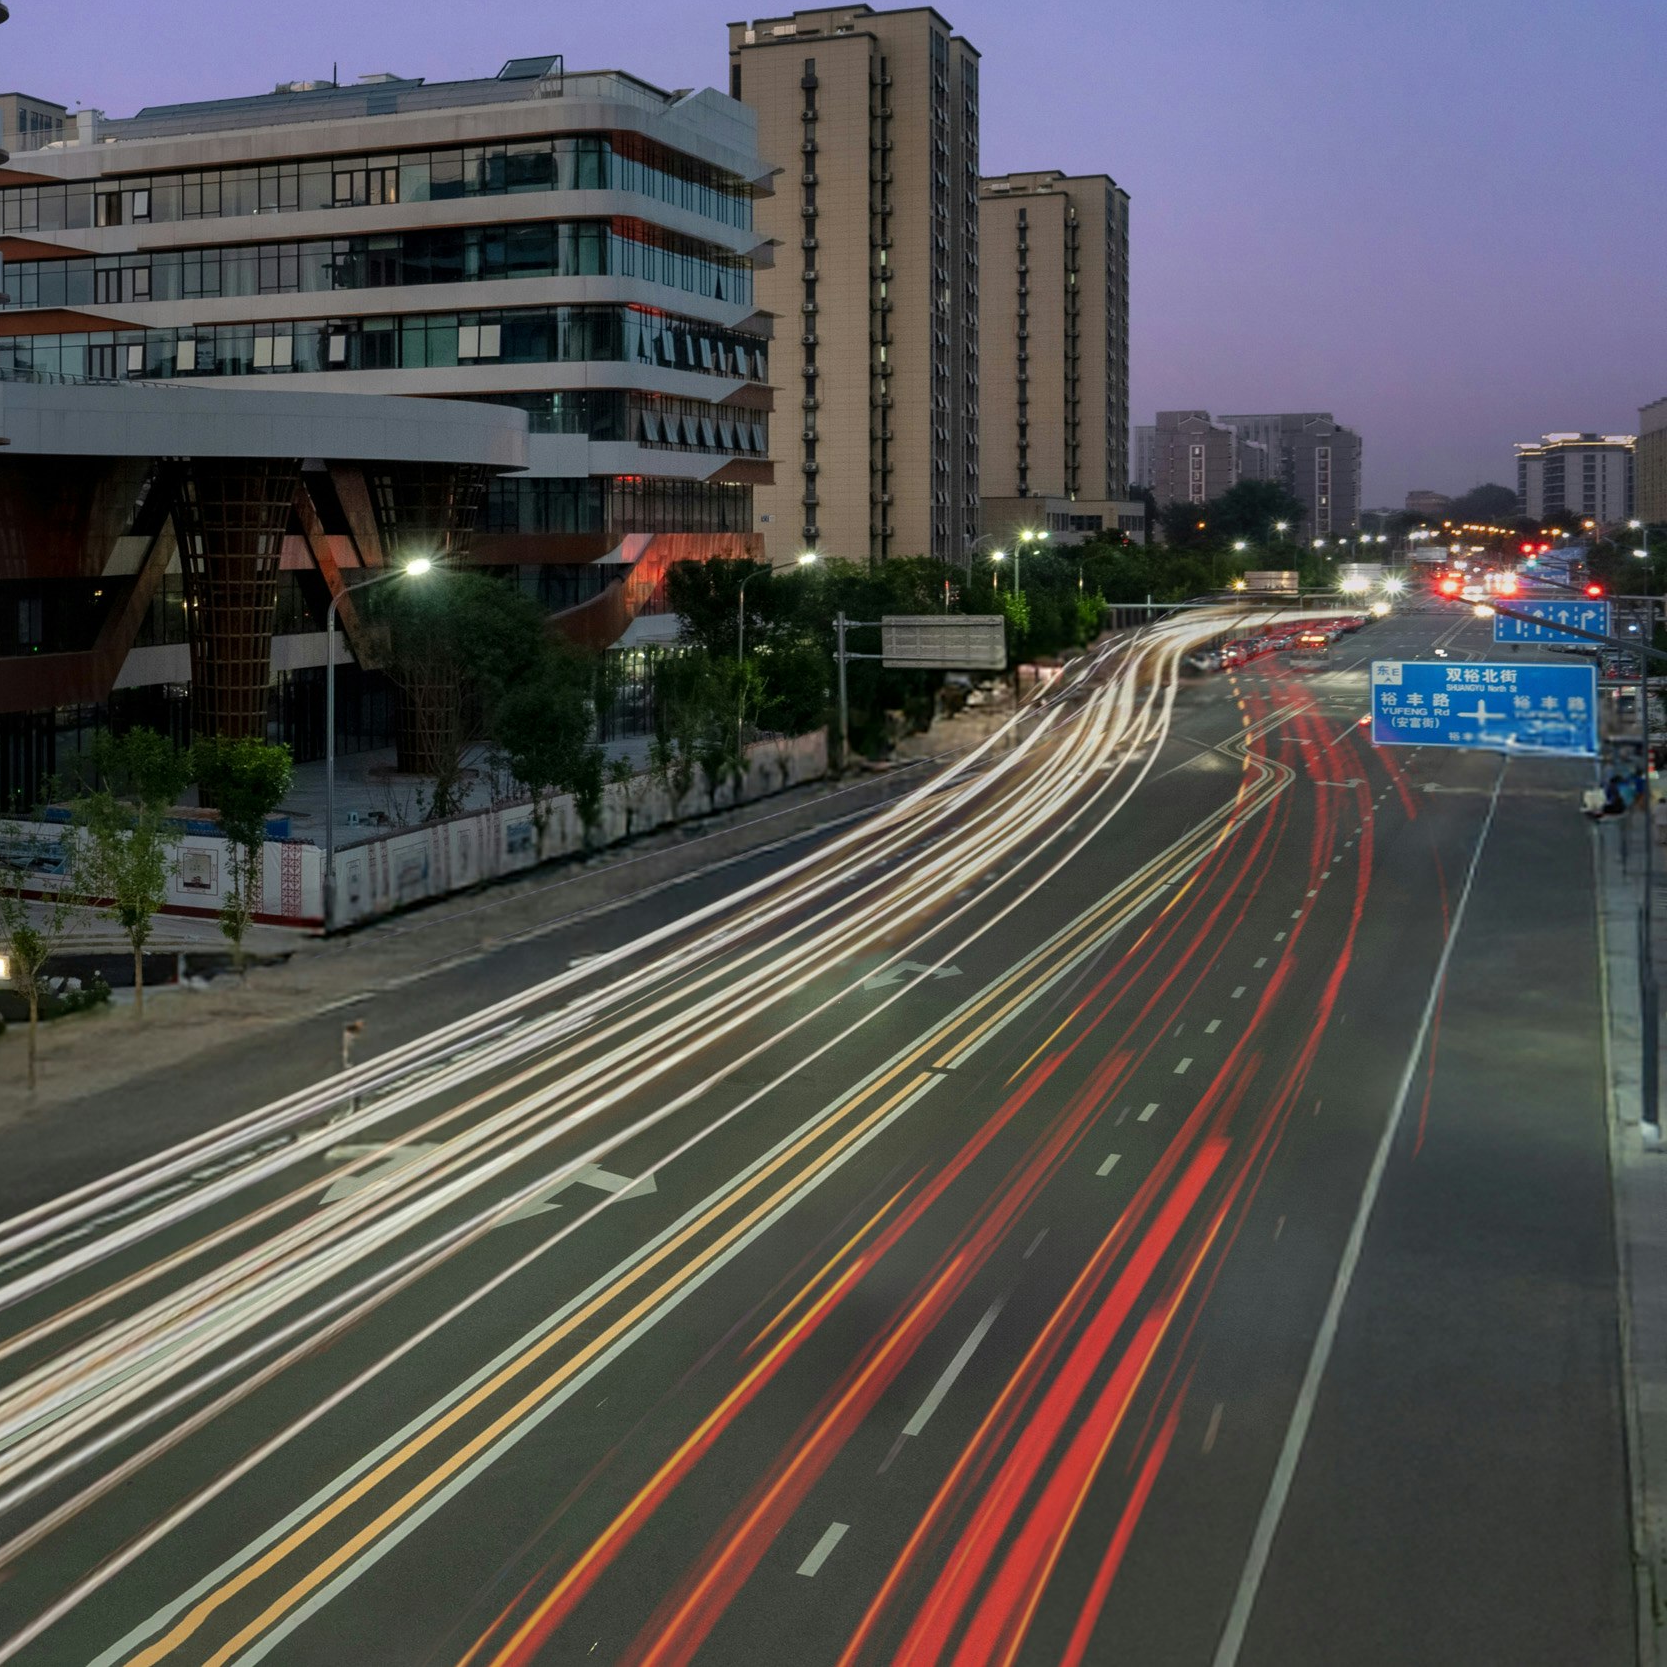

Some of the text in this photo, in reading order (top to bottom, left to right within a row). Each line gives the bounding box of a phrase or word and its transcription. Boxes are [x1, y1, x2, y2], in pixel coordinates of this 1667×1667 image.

[1377, 666, 1389, 676] 东
[1392, 668, 1400, 676] E
[1446, 667, 1517, 683] 双裕北街
[1446, 684, 1485, 692] SHUANGYU
[1380, 692, 1450, 707] 裕丰路
[1382, 707, 1450, 716] YUFENG Rd
